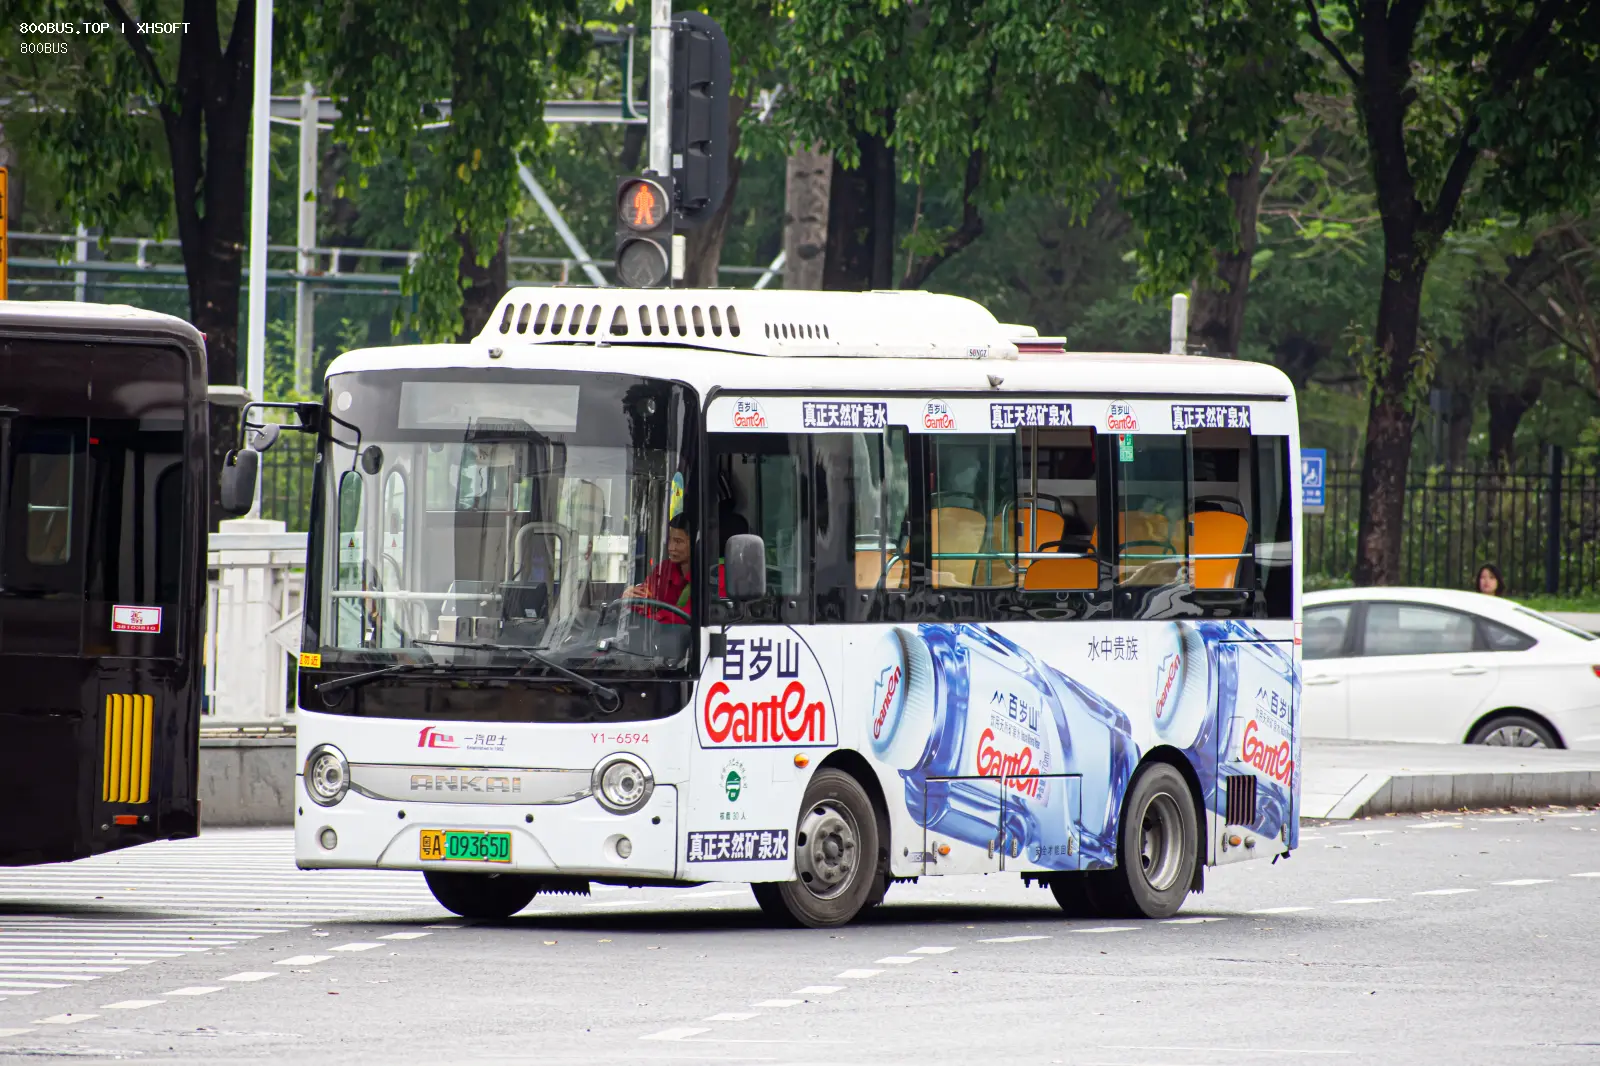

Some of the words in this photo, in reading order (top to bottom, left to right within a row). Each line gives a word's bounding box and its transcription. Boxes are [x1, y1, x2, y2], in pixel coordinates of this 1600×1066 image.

[737, 401, 758, 413] 百岁山
[804, 403, 886, 427] 真正天然矿泉水
[927, 403, 947, 414] 百岁山
[991, 404, 1071, 428] 真正天然矿泉水
[1110, 404, 1130, 415] 百岁山
[1173, 405, 1250, 428] 真正天然矿泉水
[722, 637, 799, 681] 百岁山
[1087, 635, 1139, 661] 水中贵族
[299, 653, 319, 667] 勿近
[1009, 692, 1038, 732] 百岁山
[464, 733, 508, 746] 一汽巴士
[591, 732, 649, 744] Y1-6594
[410, 775, 521, 793] ANKAI
[449, 835, 509, 858] 09365D
[689, 830, 787, 861] 真正天然矿泉水
